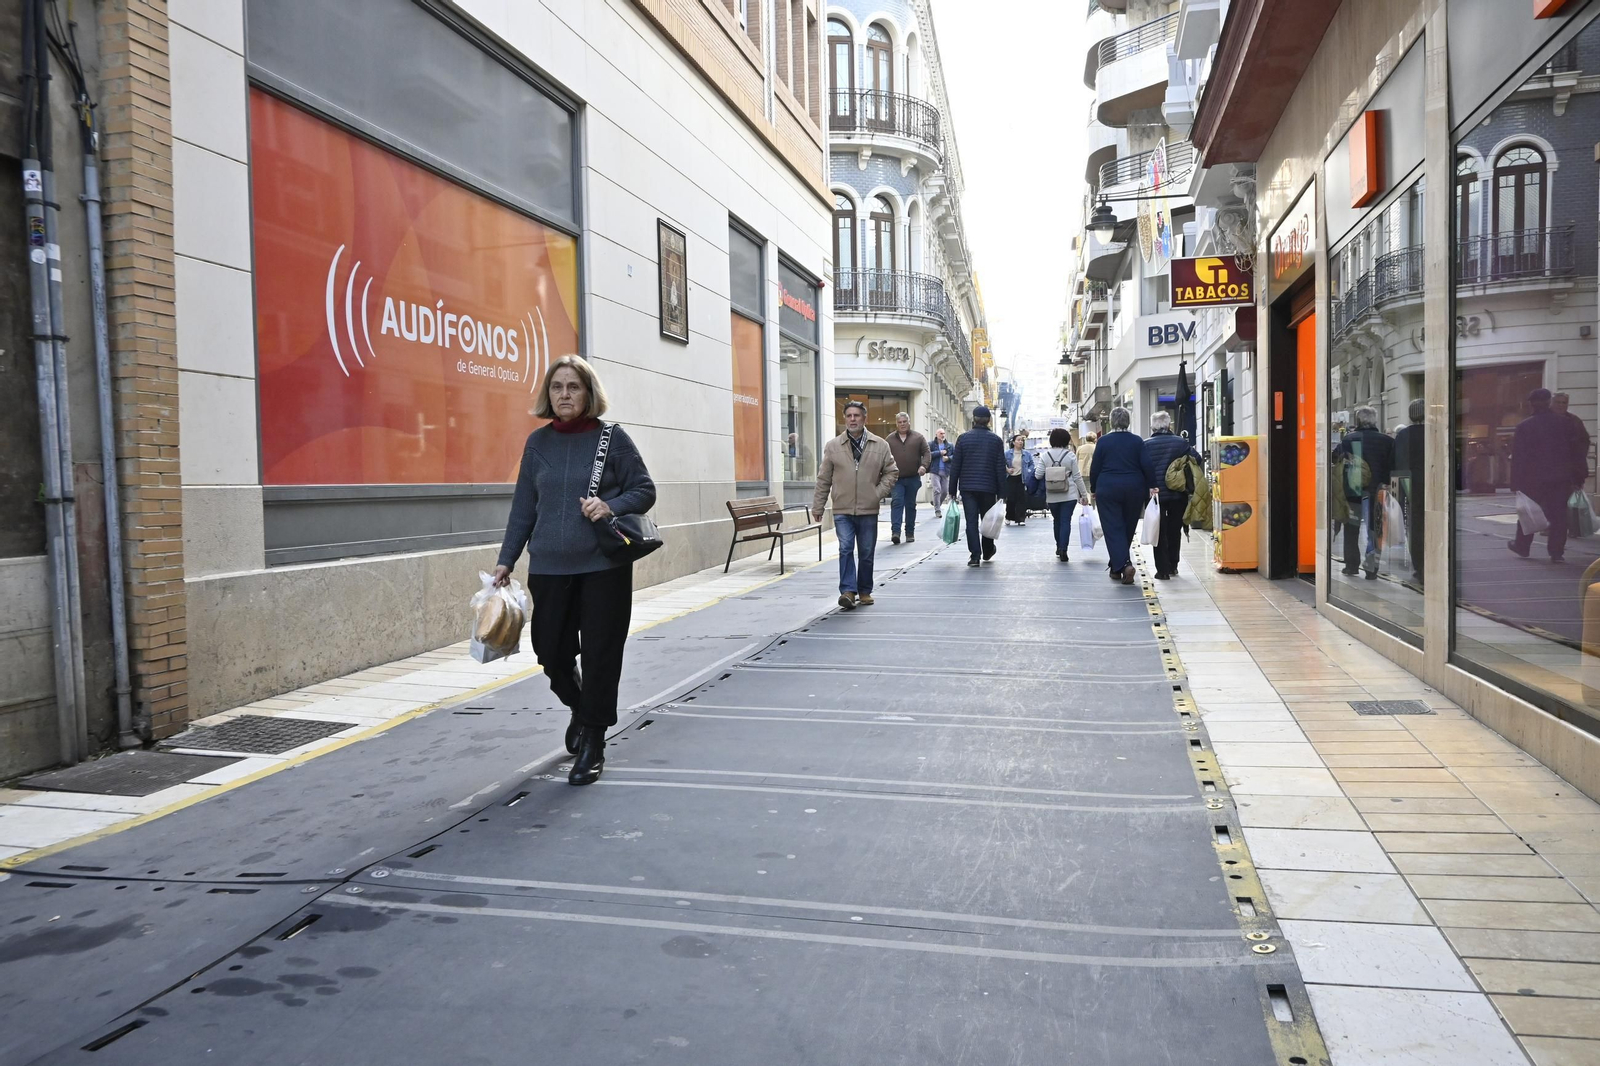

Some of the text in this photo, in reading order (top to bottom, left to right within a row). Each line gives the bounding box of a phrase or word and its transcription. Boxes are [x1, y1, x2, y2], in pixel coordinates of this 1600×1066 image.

[1274, 213, 1309, 279] Orange
[783, 288, 801, 314] General
[1175, 283, 1249, 300] TABACOS
[380, 296, 519, 362] AUDÍFONOS
[1148, 320, 1197, 346] BBV
[867, 340, 910, 361] Sfera
[456, 358, 520, 383] de General Optica
